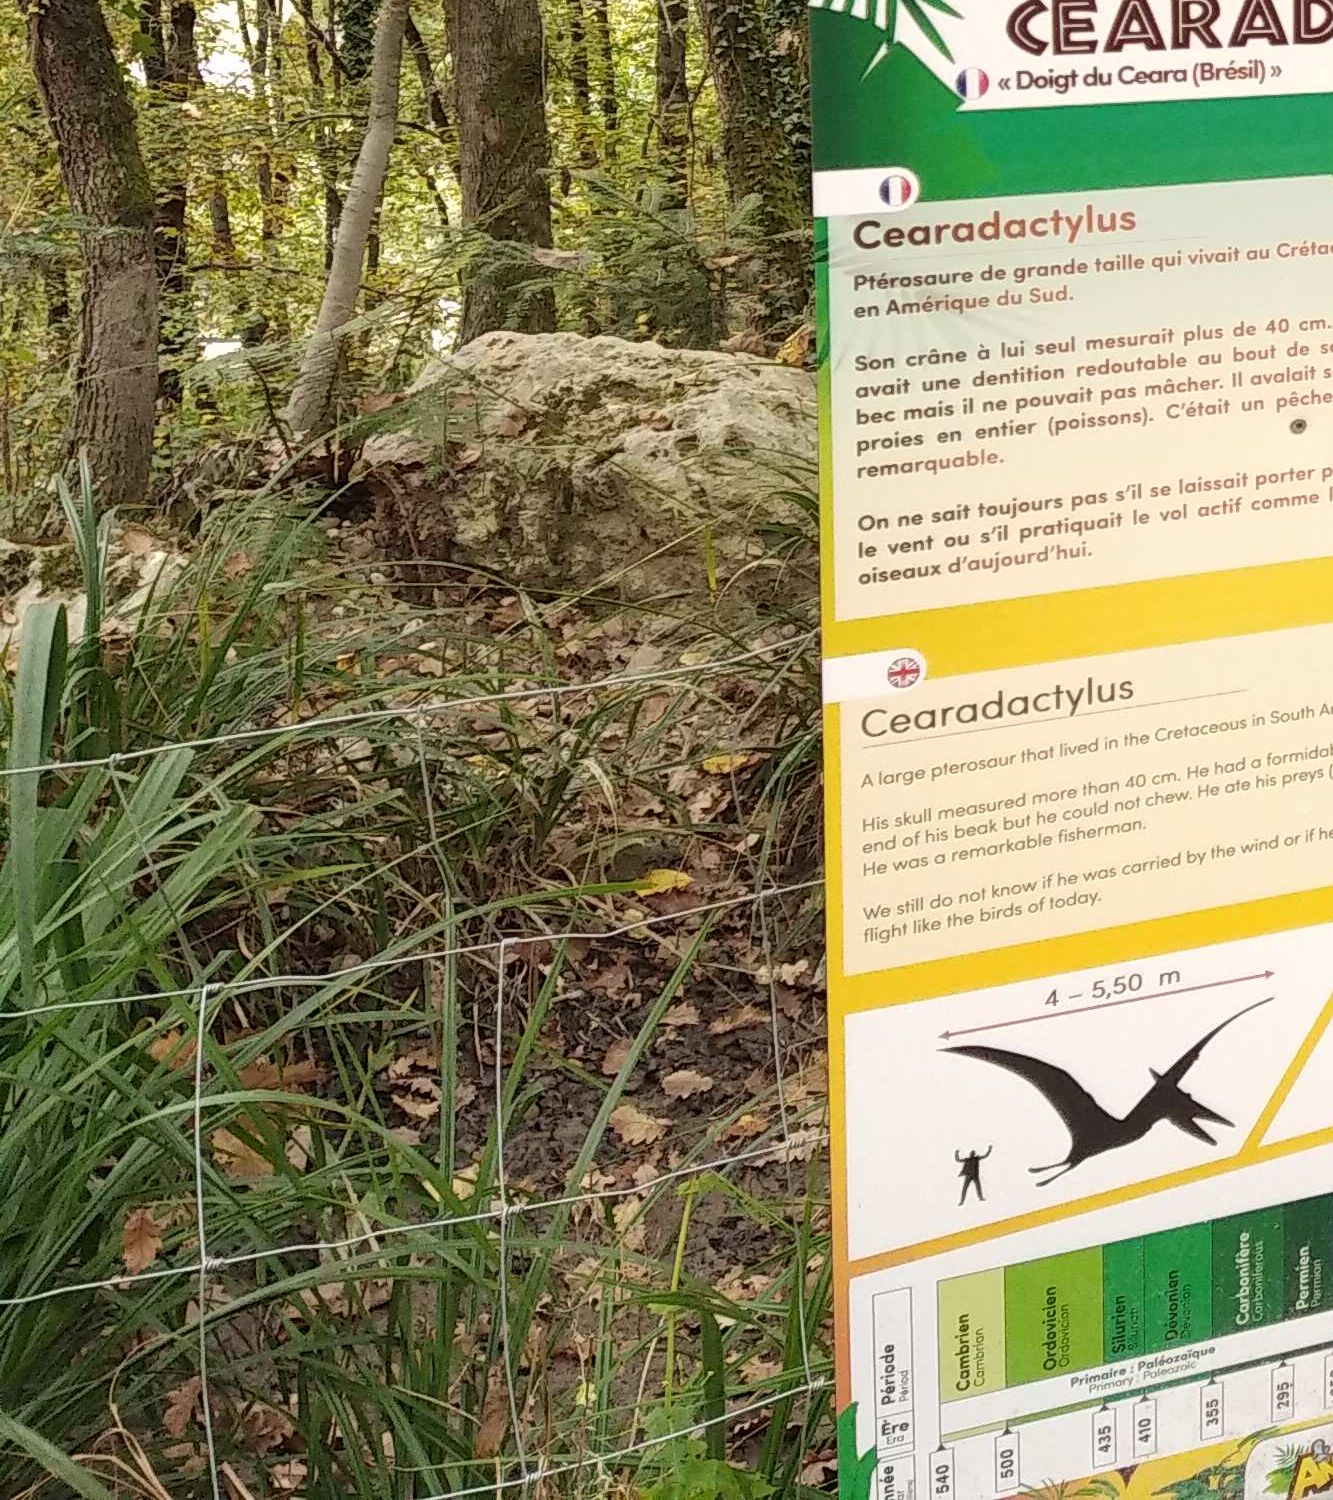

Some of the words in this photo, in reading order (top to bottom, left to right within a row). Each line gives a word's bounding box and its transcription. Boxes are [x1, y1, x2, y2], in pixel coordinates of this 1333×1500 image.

[1015, 68, 1079, 94] Doigt
[1082, 65, 1112, 87] du
[1117, 65, 1187, 85] Ceara
[1192, 58, 1265, 87] (Brésil)
[853, 203, 1136, 249] Cearadactylus
[853, 270, 973, 291] Ptérosaure
[979, 264, 1006, 281] de
[1013, 257, 1088, 283] grande
[1093, 253, 1145, 272] taille
[1150, 249, 1181, 272] qui
[1187, 246, 1240, 265] vivait
[1245, 247, 1270, 260] au
[853, 304, 879, 318] en
[885, 293, 990, 315] Amérique
[995, 288, 1022, 306] du
[1029, 284, 1073, 303] Sud.
[854, 354, 895, 371] Son
[905, 348, 967, 367] crâne
[977, 343, 990, 360] à
[1000, 339, 1024, 358] lui
[1034, 335, 1075, 355] seul
[1085, 327, 1174, 350] mesurait
[1183, 323, 1224, 346] plus
[1232, 320, 1256, 337] de
[1264, 317, 1289, 334] 40
[1298, 318, 1332, 331] cm.
[855, 377, 910, 398] avait
[921, 377, 960, 392] une
[971, 364, 1064, 387] dentition
[1076, 351, 1187, 377] redoutable
[1197, 352, 1221, 365] au
[1232, 344, 1276, 362] bout
[1286, 340, 1309, 357] de
[856, 430, 924, 456] proies
[936, 429, 961, 443] en
[975, 419, 1037, 439] entier
[1047, 406, 1154, 436] (poissons).
[1165, 397, 1230, 419] C'était
[1241, 398, 1264, 412] un
[857, 448, 1004, 478] remarquable.
[858, 563, 941, 585] oiseaux
[947, 540, 1092, 573] d'aujourd'hui.
[860, 676, 1133, 737] Cearadactylus
[860, 773, 874, 788] A
[878, 768, 925, 786] large
[930, 753, 1016, 782] pterosaur
[1020, 745, 1054, 763] that
[1059, 737, 1098, 757] lived
[1103, 736, 1118, 750] in
[1123, 731, 1150, 747] the
[1154, 718, 1247, 742] Cretaceous
[1251, 713, 1265, 727] in
[1269, 705, 1315, 724] South
[862, 860, 887, 876] He
[891, 855, 928, 871] was
[933, 852, 946, 864] a
[951, 832, 1053, 862] remarkable
[1057, 819, 1146, 844] fisherman.
[863, 922, 907, 944] flight
[912, 917, 941, 934] like
[946, 912, 974, 928] the
[979, 901, 1023, 922] birds
[1027, 895, 1045, 913] of
[1049, 890, 1101, 909] today.
[1044, 988, 1059, 1007] 4
[1091, 973, 1143, 1000] 5,50
[1159, 970, 1181, 986] m
[1294, 1245, 1310, 1310] Permien
[1310, 1258, 1322, 1308] Permian
[1042, 1285, 1057, 1371] Ordovicien
[1058, 1303, 1071, 1367] Ordovician
[1111, 1295, 1126, 1354] Silurien
[879, 1343, 895, 1406] Période
[955, 1313, 970, 1392] Cambrien
[973, 1327, 985, 1387] Cambrian
[1070, 1366, 1127, 1388] Primaire
[1088, 1375, 1134, 1394] Primary
[1276, 1381, 1291, 1410] 295
[1138, 1418, 1151, 1443] 410
[1206, 1399, 1219, 1427] 355
[1098, 1425, 1112, 1453] 435
[879, 1465, 895, 1500] nnée
[935, 1464, 950, 1494] 540
[1000, 1449, 1014, 1479] 500
